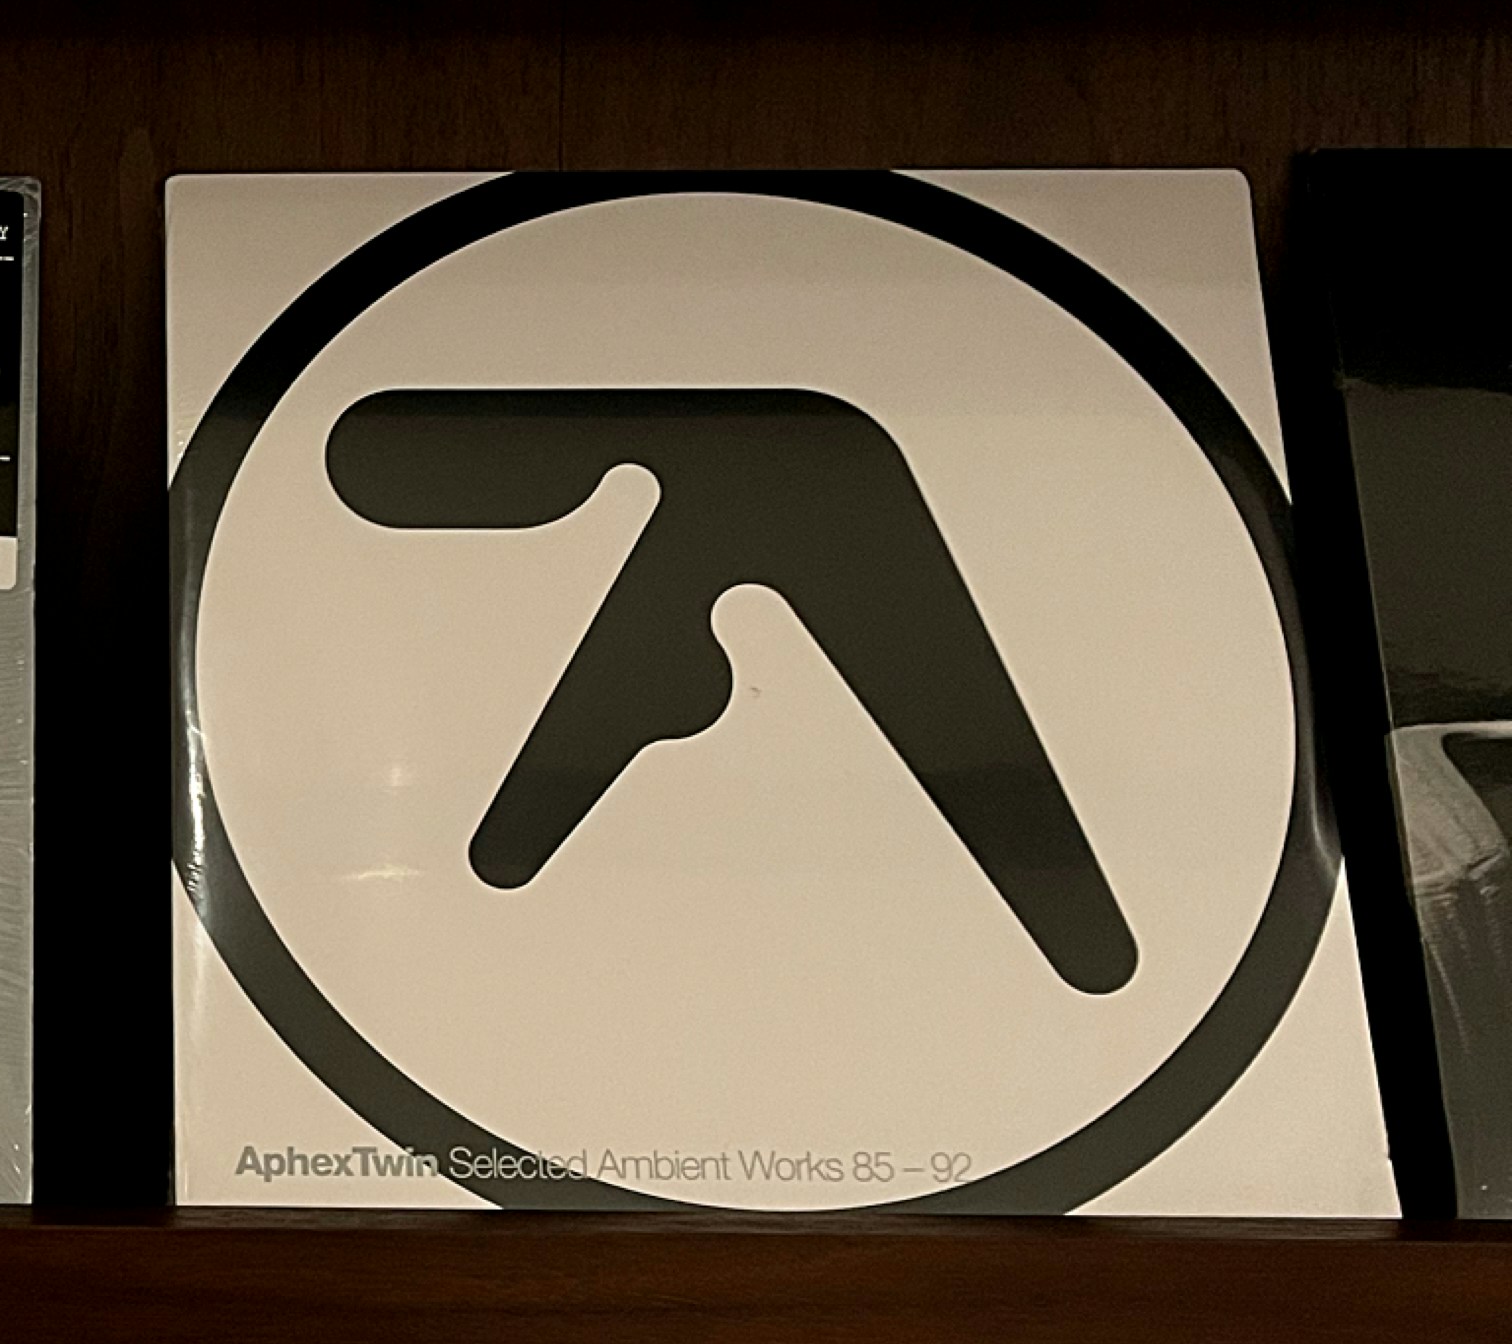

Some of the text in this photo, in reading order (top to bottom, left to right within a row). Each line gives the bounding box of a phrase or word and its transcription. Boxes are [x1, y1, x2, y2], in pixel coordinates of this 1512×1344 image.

[448, 1145, 589, 1180] Selected
[596, 1148, 733, 1182] Ambient
[738, 1149, 845, 1183] Works
[852, 1151, 895, 1184] 85
[930, 1152, 972, 1184] 92
